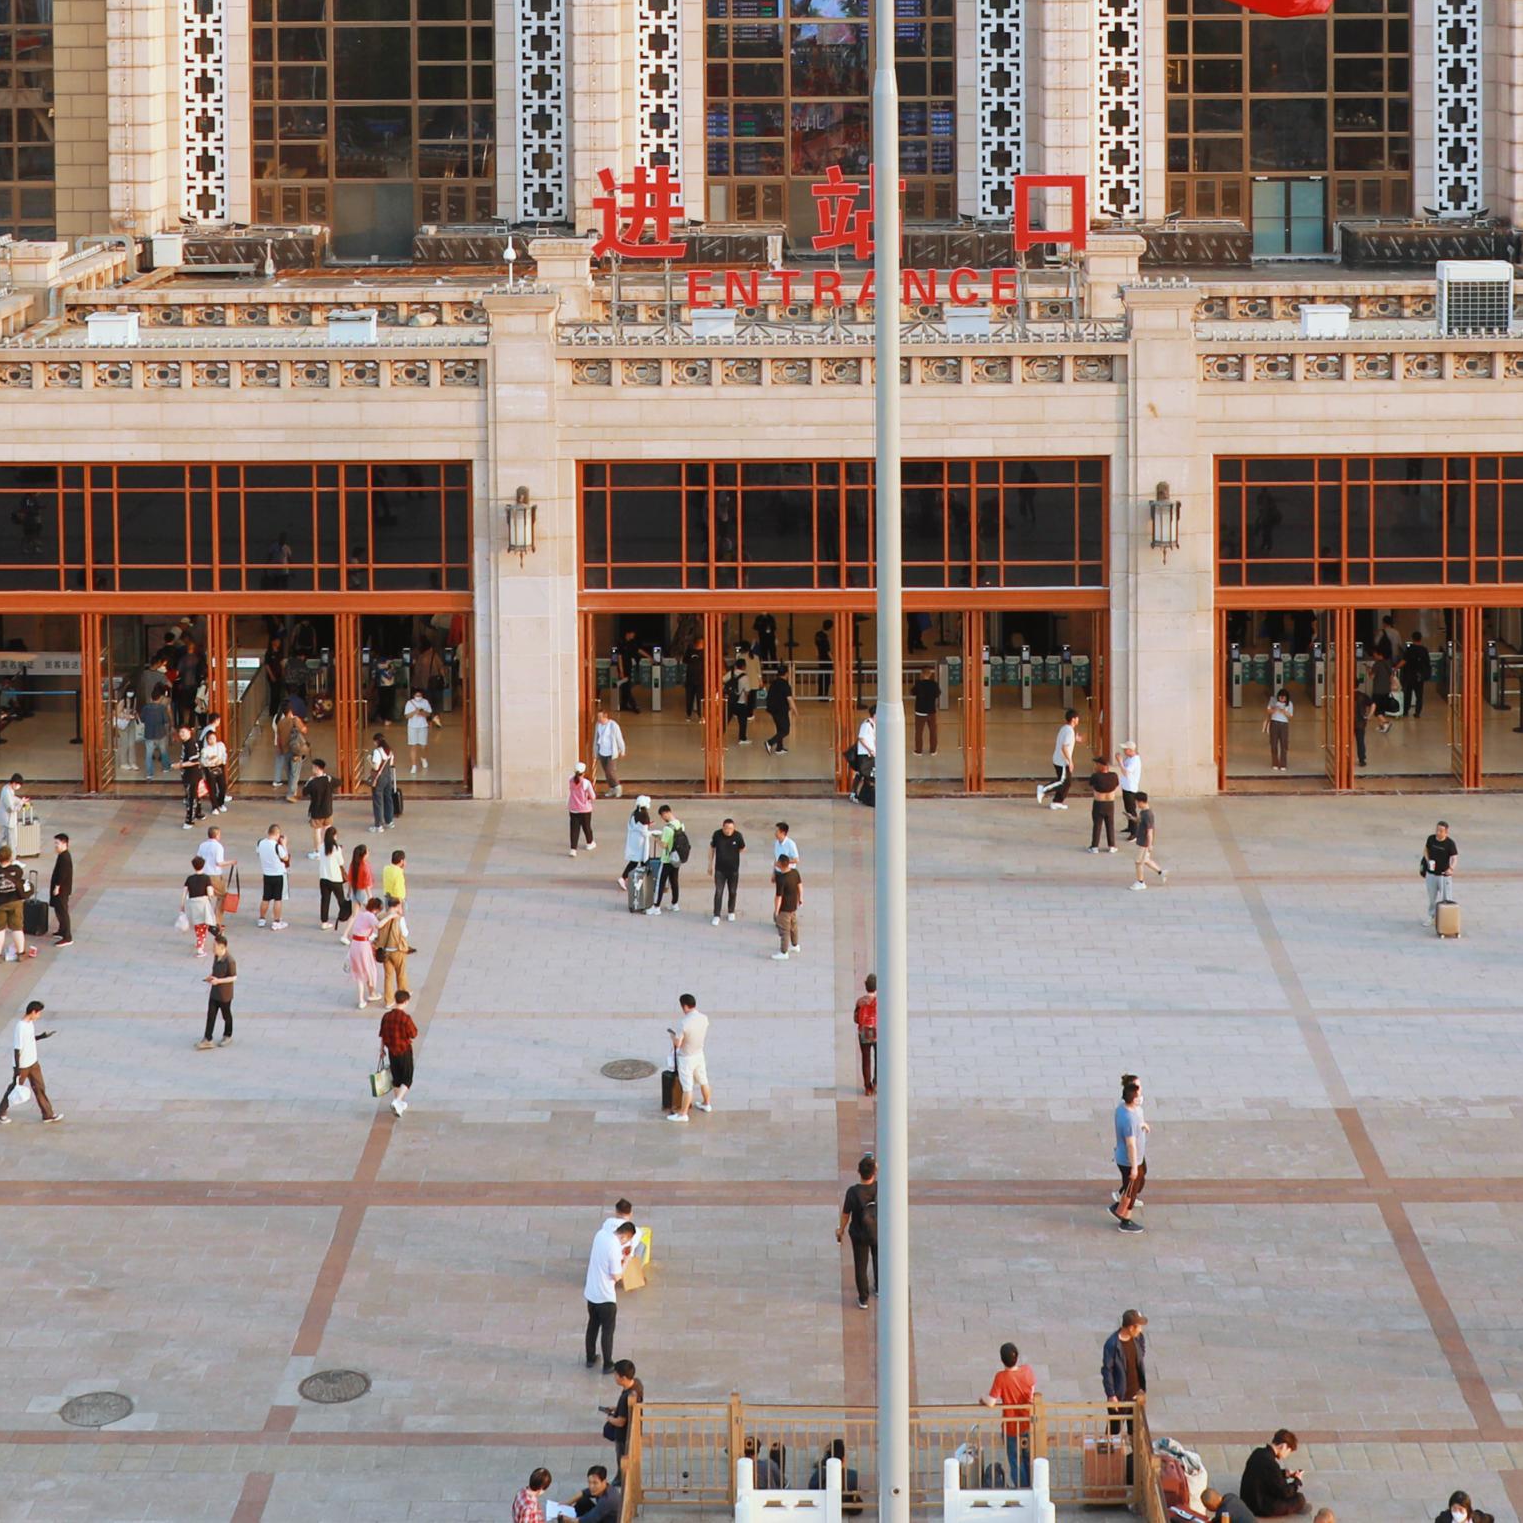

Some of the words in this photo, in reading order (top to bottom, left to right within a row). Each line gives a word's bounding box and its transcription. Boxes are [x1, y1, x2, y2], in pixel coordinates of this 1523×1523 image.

[591, 164, 1088, 260] 进站口
[686, 268, 1018, 309] ENTRANCE
